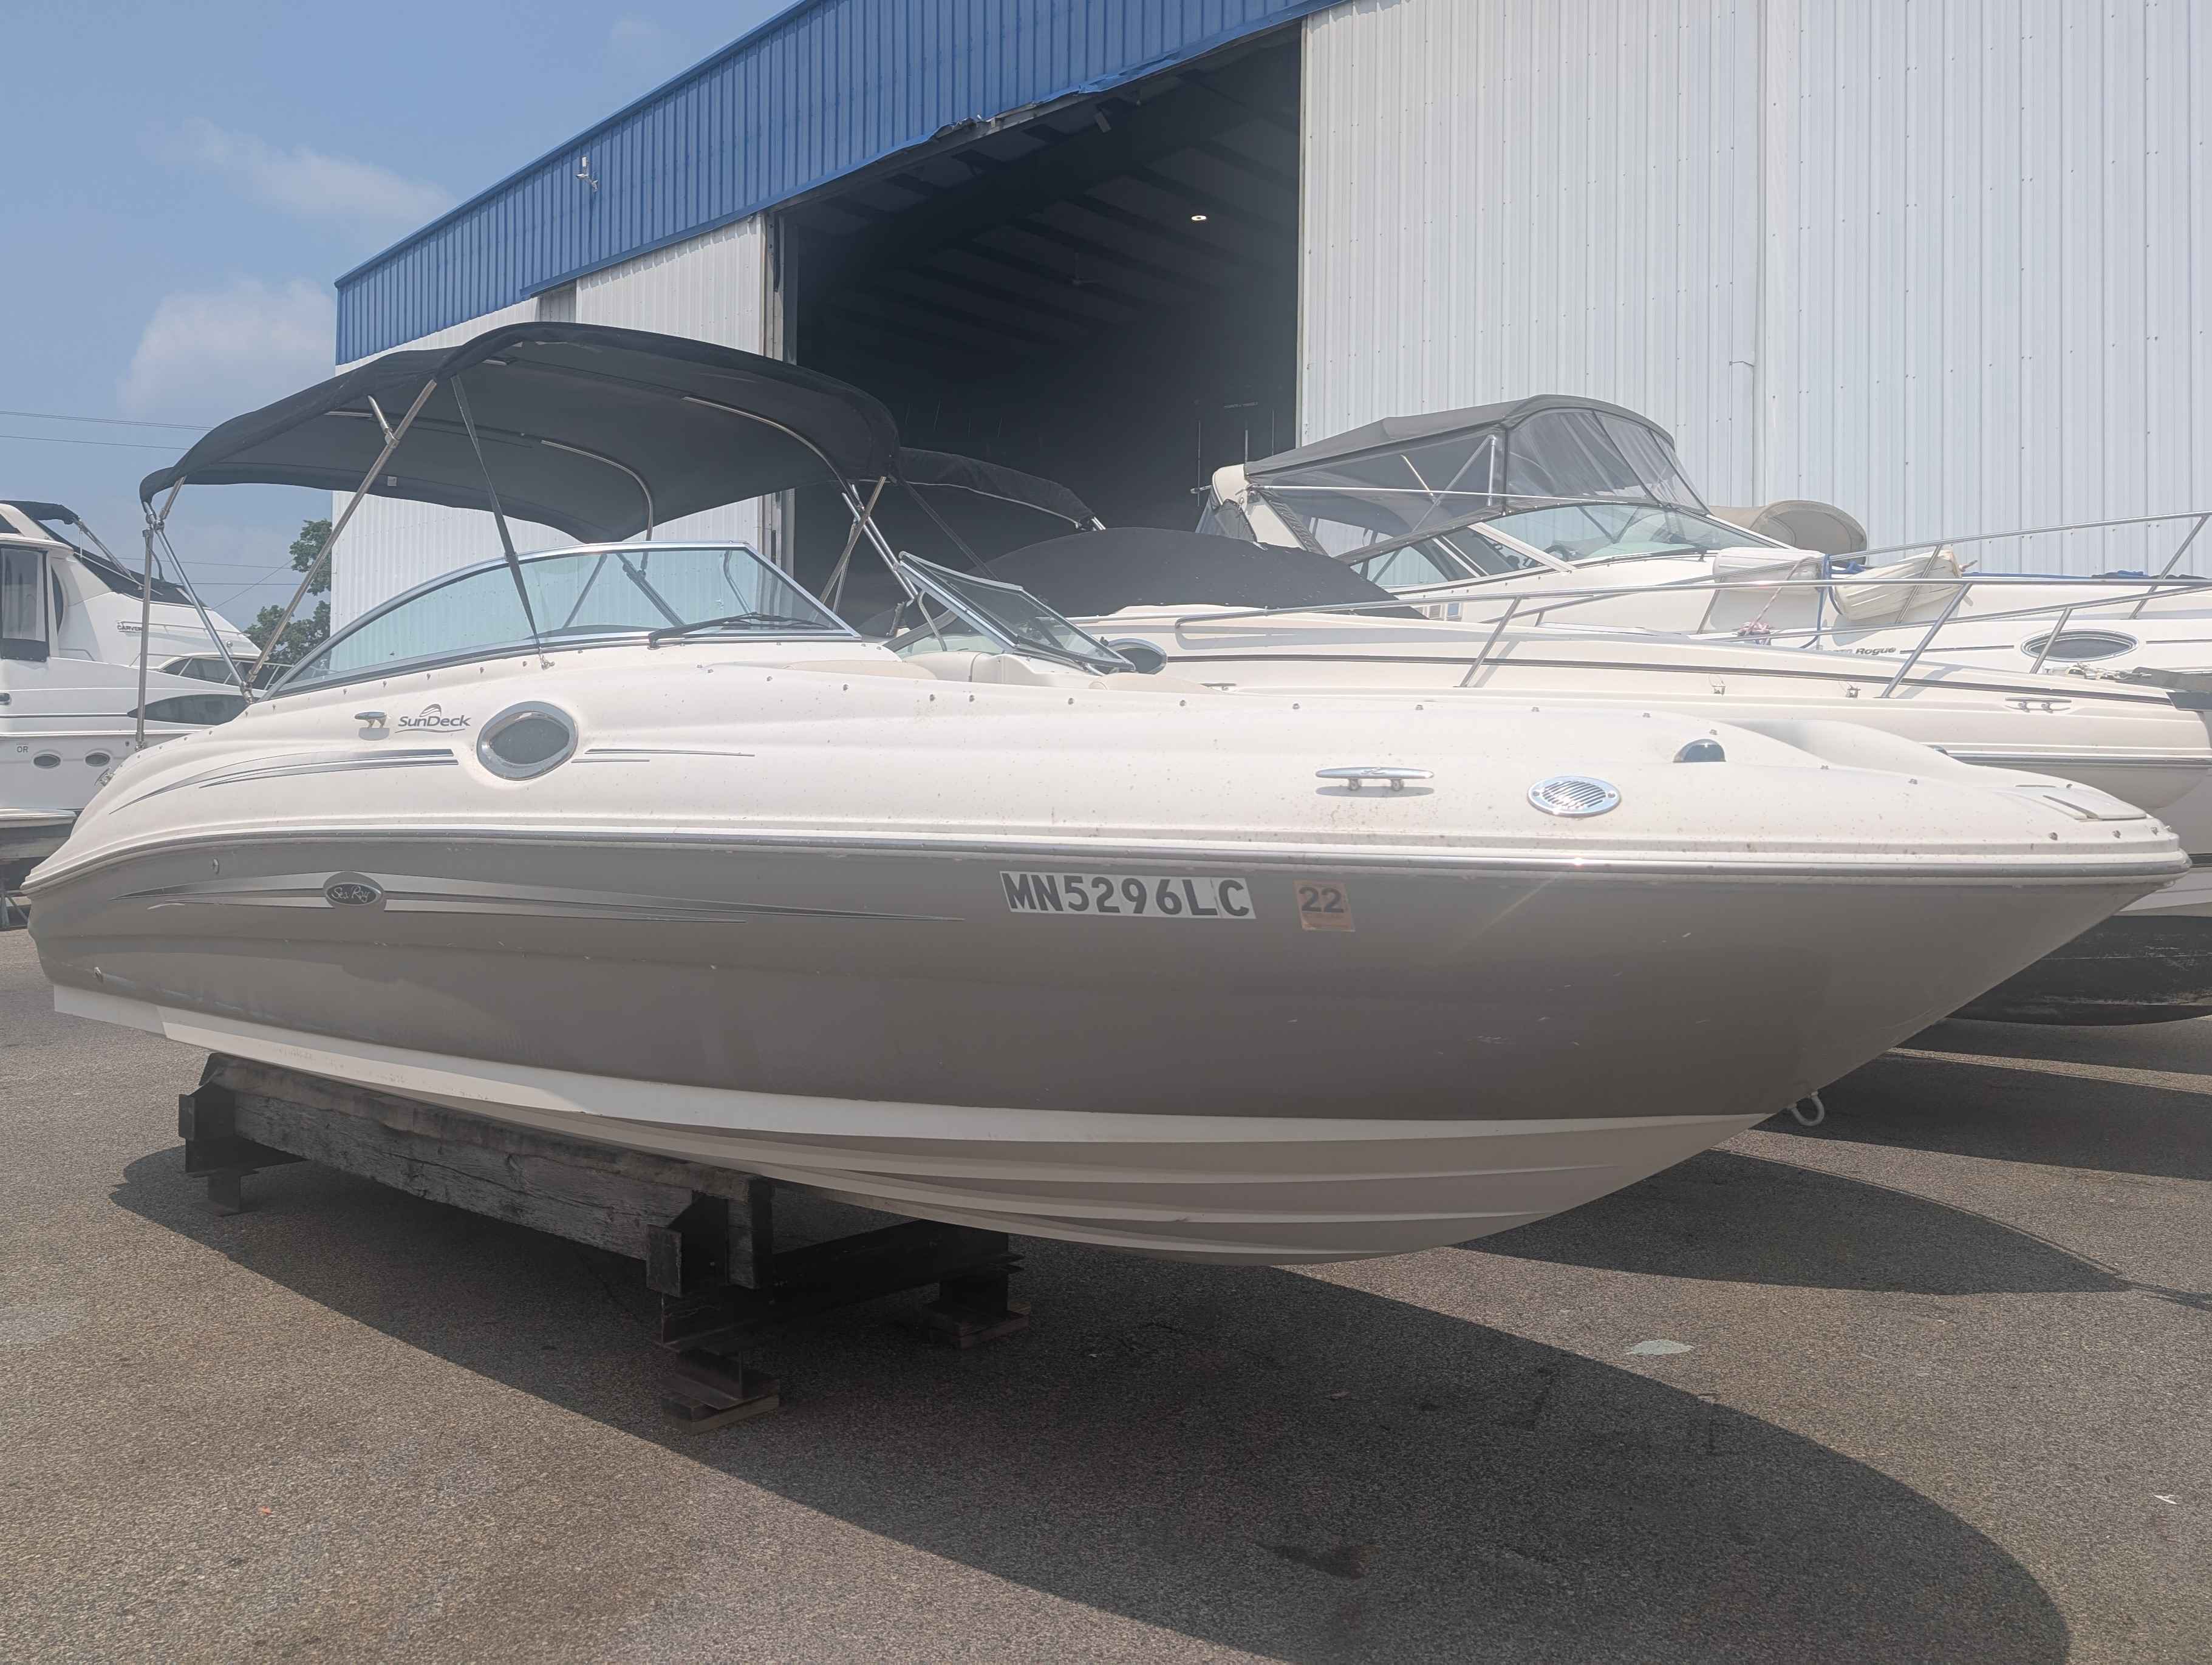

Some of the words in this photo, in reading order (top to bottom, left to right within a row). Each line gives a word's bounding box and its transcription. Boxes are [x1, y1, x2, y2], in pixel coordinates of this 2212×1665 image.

[398, 715, 471, 727] SunDeck
[331, 887, 349, 899] Sea
[350, 885, 370, 903] Ray
[1001, 873, 1249, 917] MN5296LC
[1299, 887, 1345, 913] 22
